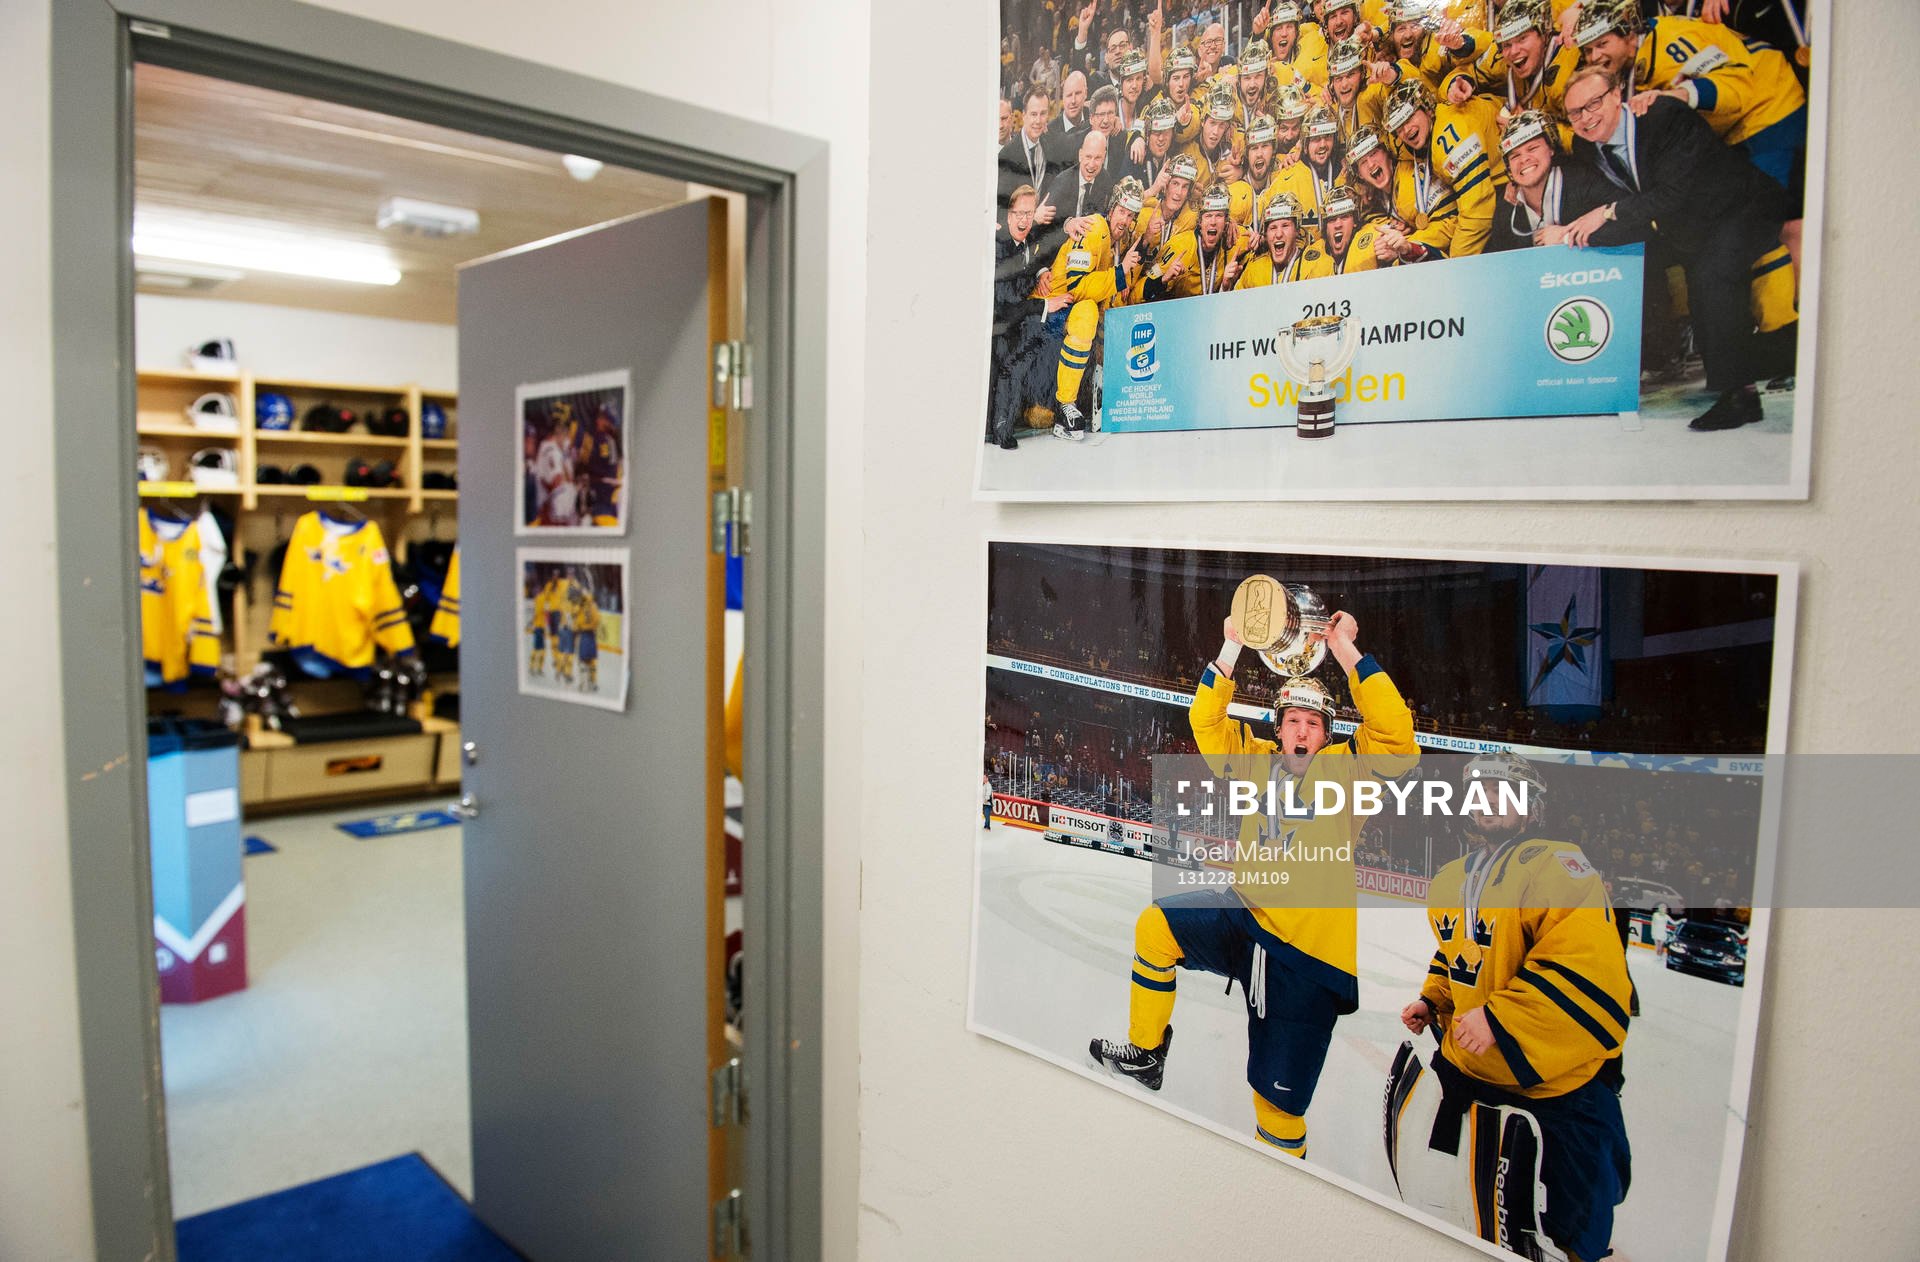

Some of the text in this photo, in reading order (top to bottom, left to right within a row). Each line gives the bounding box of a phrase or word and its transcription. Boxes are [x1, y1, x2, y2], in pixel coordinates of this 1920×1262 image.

[1666, 37, 1698, 63] 81
[1437, 123, 1461, 154] 27
[1540, 267, 1622, 289] ŠKODA
[1134, 312, 1153, 322] 2013
[1134, 328, 1153, 340] IIHF
[1209, 340, 1247, 361] IIHF
[1248, 367, 1407, 408] Swden
[1011, 661, 1043, 674] SWEDEN
[1049, 669, 1121, 691] CONGRATULATIONS
[1122, 684, 1133, 692] TO
[1134, 686, 1149, 696] THE
[1151, 690, 1171, 701] GOLD
[1416, 734, 1428, 743] TO
[1430, 736, 1449, 746] THE
[1451, 739, 1476, 750] GOLD
[1066, 816, 1106, 833] TISSOT
[1355, 870, 1427, 899] BAUHAU
